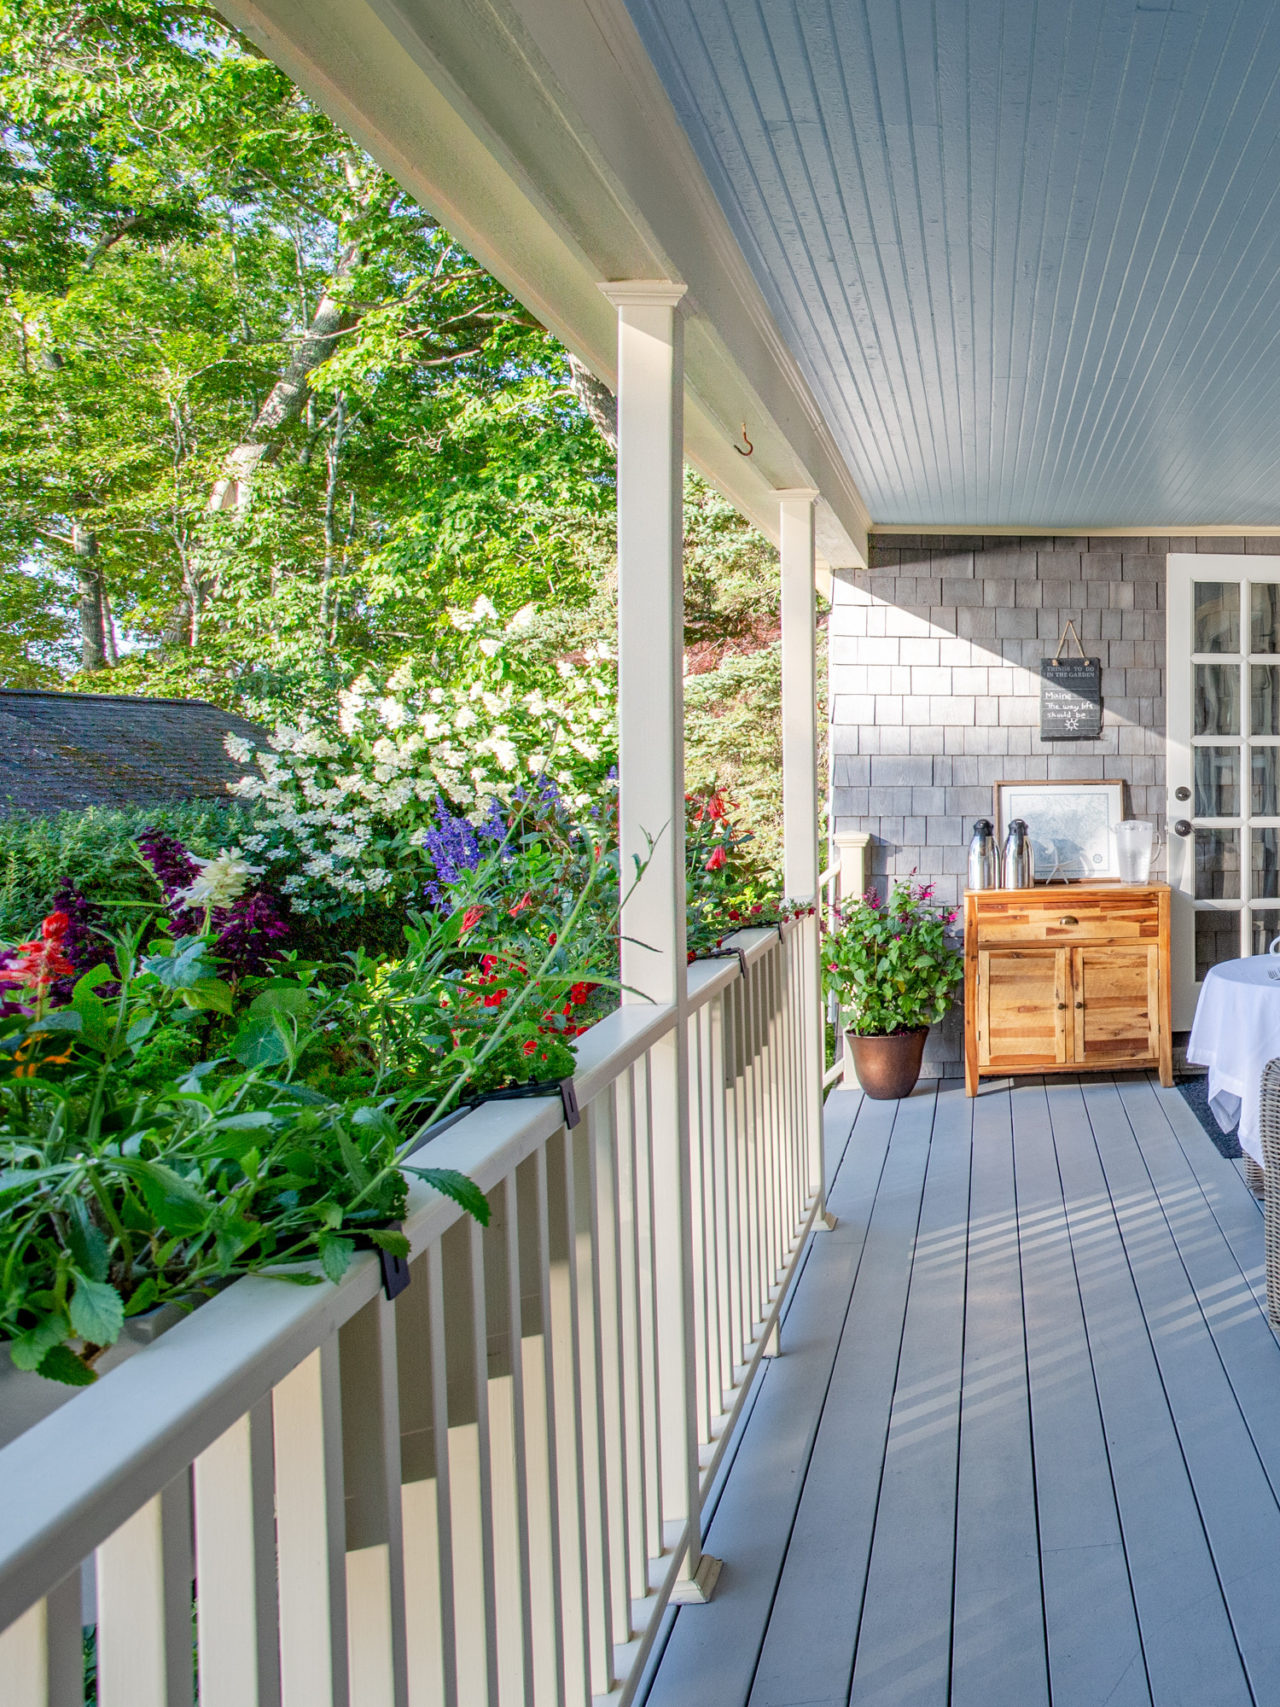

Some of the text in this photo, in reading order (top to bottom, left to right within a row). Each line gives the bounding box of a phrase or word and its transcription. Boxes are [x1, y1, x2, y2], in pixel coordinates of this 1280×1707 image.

[1045, 692, 1072, 700] Maine
[1045, 702, 1059, 710] The
[1063, 704, 1079, 712] way
[1048, 711, 1071, 719] should
